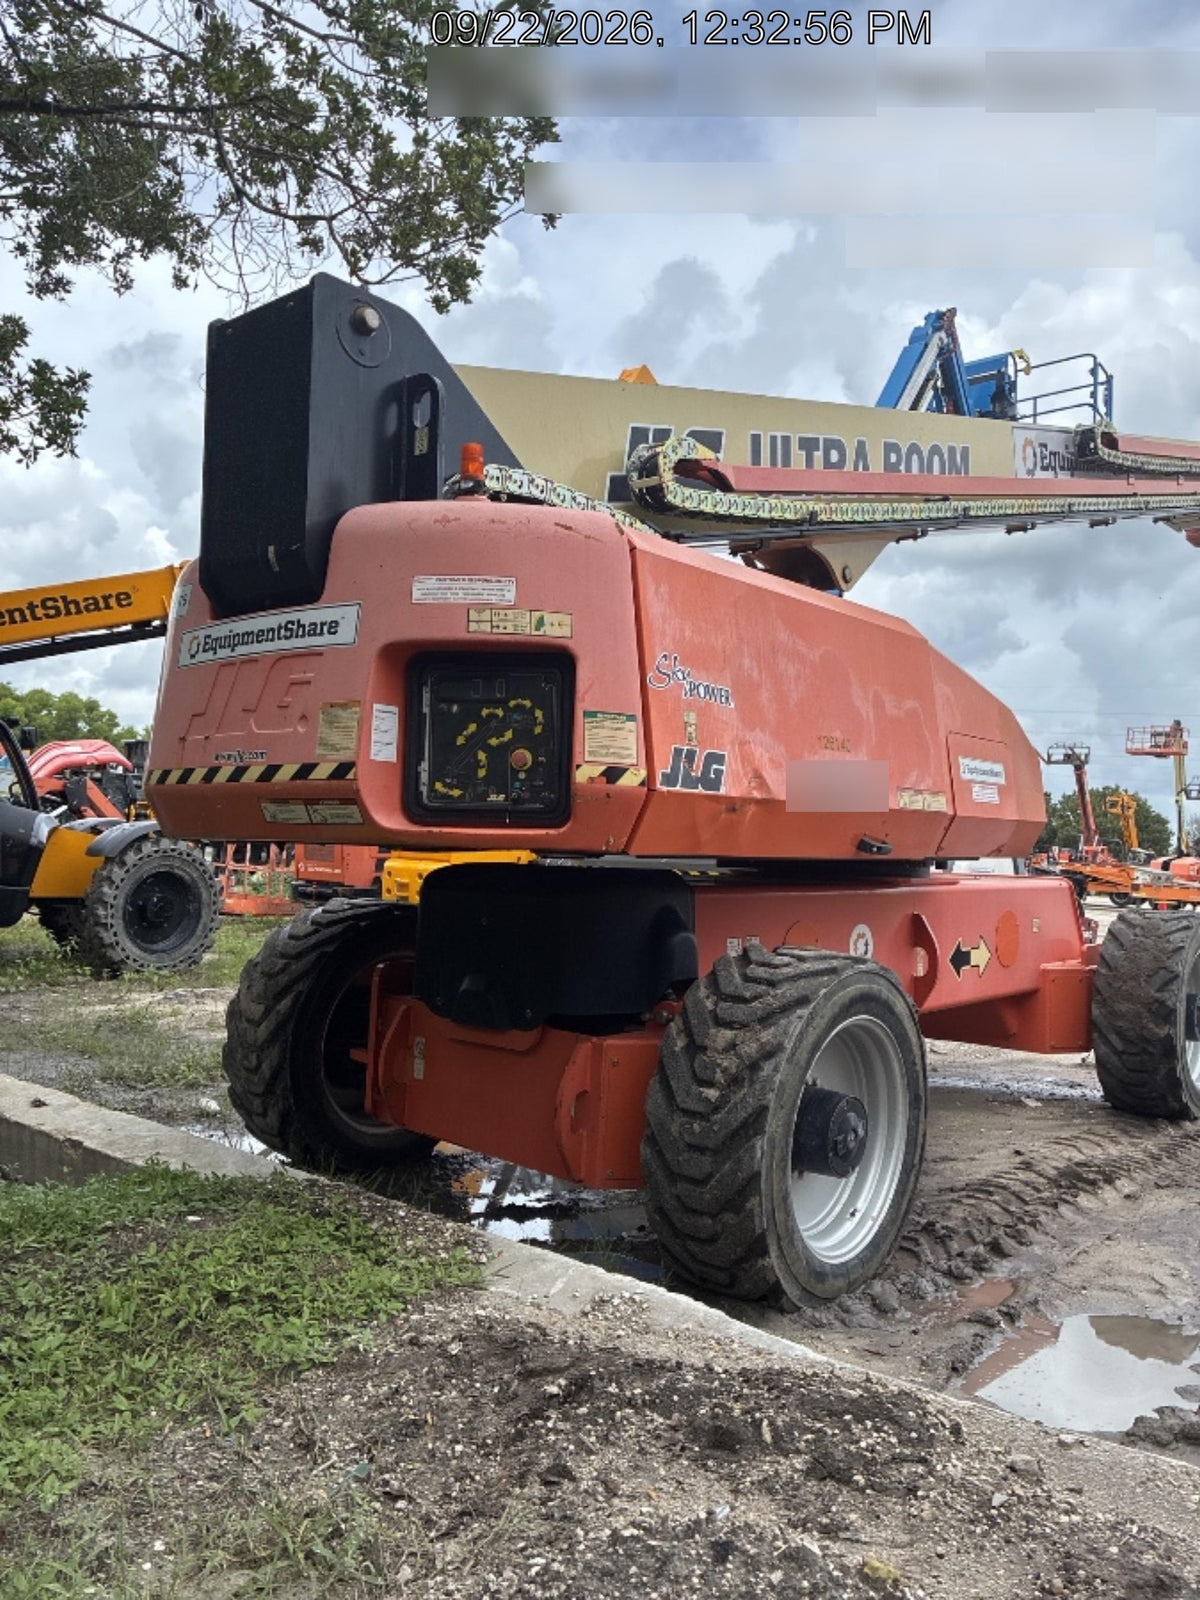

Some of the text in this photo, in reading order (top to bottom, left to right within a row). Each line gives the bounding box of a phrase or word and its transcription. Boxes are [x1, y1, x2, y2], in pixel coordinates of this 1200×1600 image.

[0, 590, 134, 626] entShare
[201, 618, 341, 656] EquipmentShare
[659, 745, 726, 792] JLG
